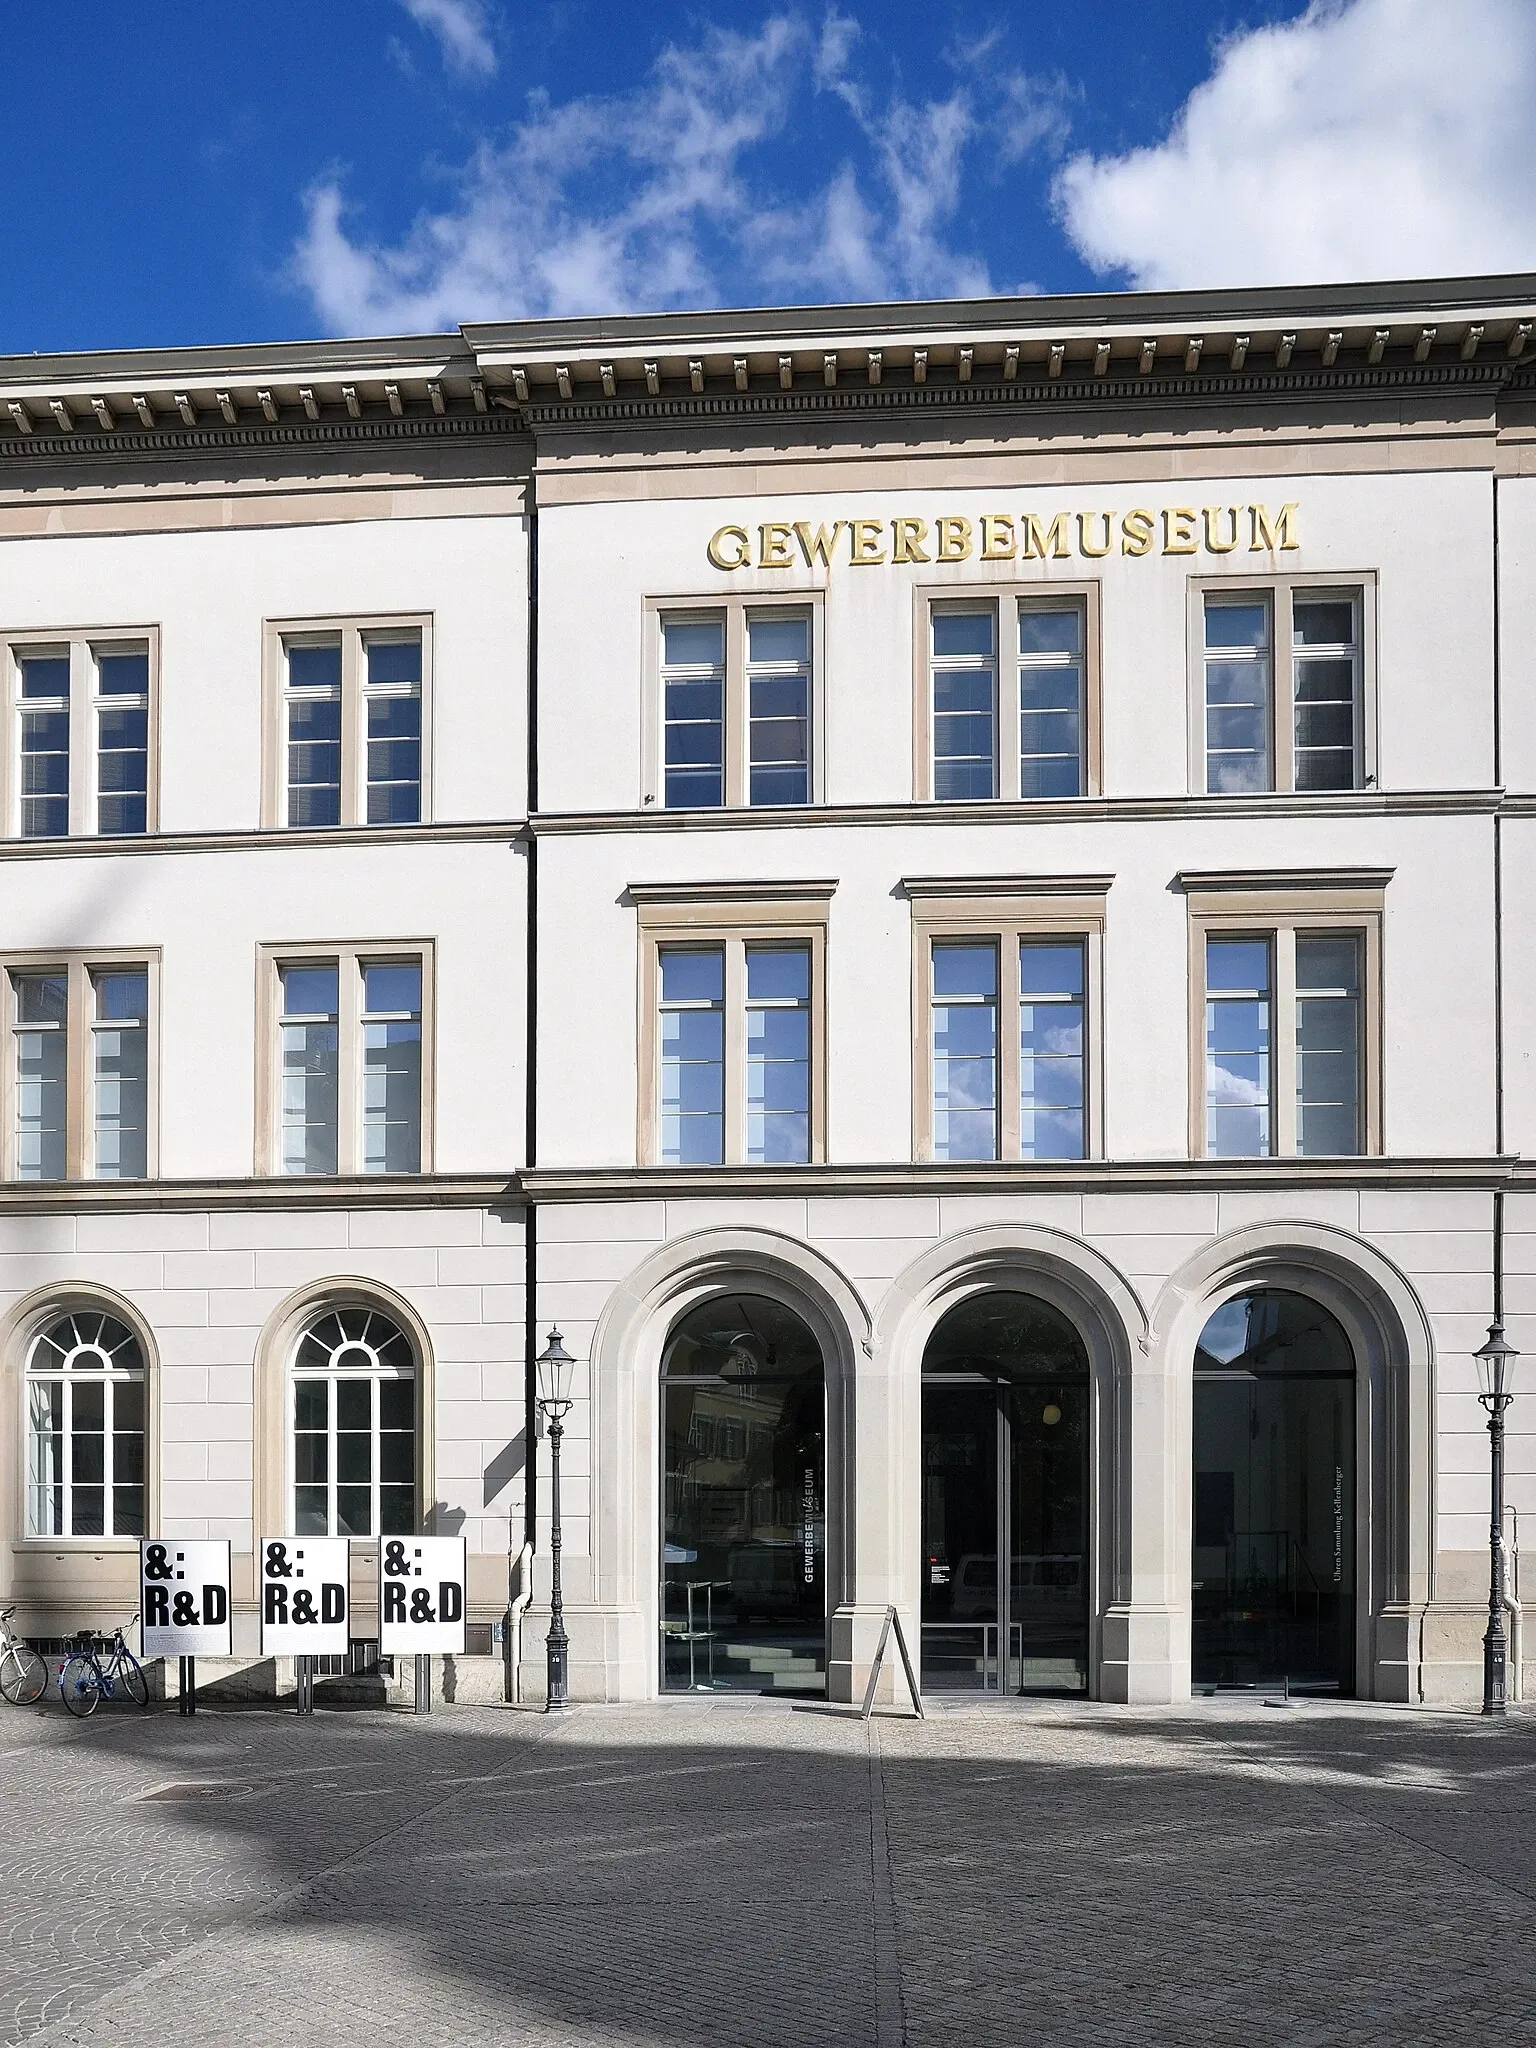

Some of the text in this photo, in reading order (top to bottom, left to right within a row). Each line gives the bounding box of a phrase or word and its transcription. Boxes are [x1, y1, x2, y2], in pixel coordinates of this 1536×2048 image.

[707, 503, 1300, 572] GEWERBEMUSEUM
[804, 1468, 814, 1583] GEWERBEMUSEUM
[1333, 1466, 1344, 1582] Uhren Sammlung Kellenberger
[144, 1584, 227, 1627] R&D
[265, 1583, 345, 1625] R&D
[384, 1581, 462, 1623] R&D
